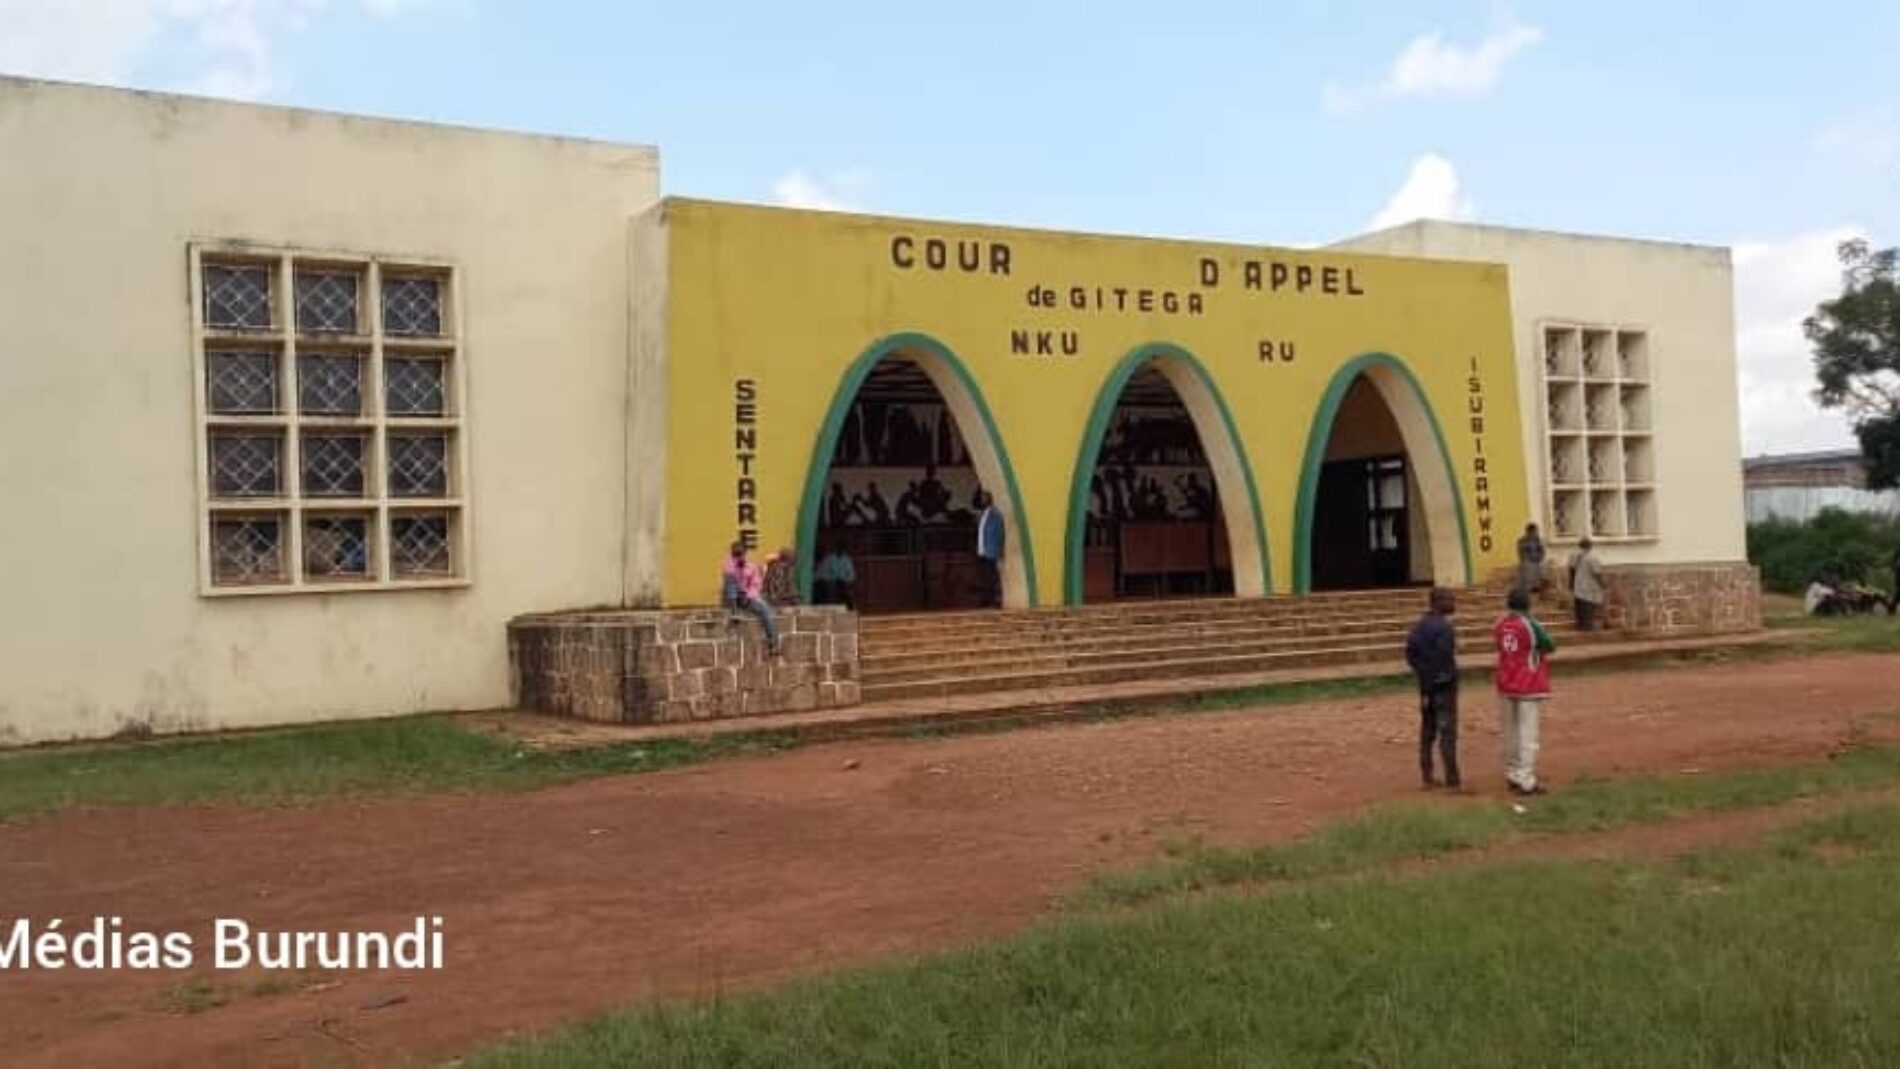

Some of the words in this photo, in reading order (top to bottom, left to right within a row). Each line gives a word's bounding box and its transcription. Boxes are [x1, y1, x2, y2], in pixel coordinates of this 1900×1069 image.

[891, 236, 1011, 275] COUR
[1027, 284, 1056, 308] de
[1069, 287, 1204, 315] GITEGA
[1011, 330, 1078, 356] NKU
[1259, 341, 1295, 363] RU
[736, 380, 758, 550] SENTARE
[1468, 356, 1493, 552] ISUBIRAMWO
